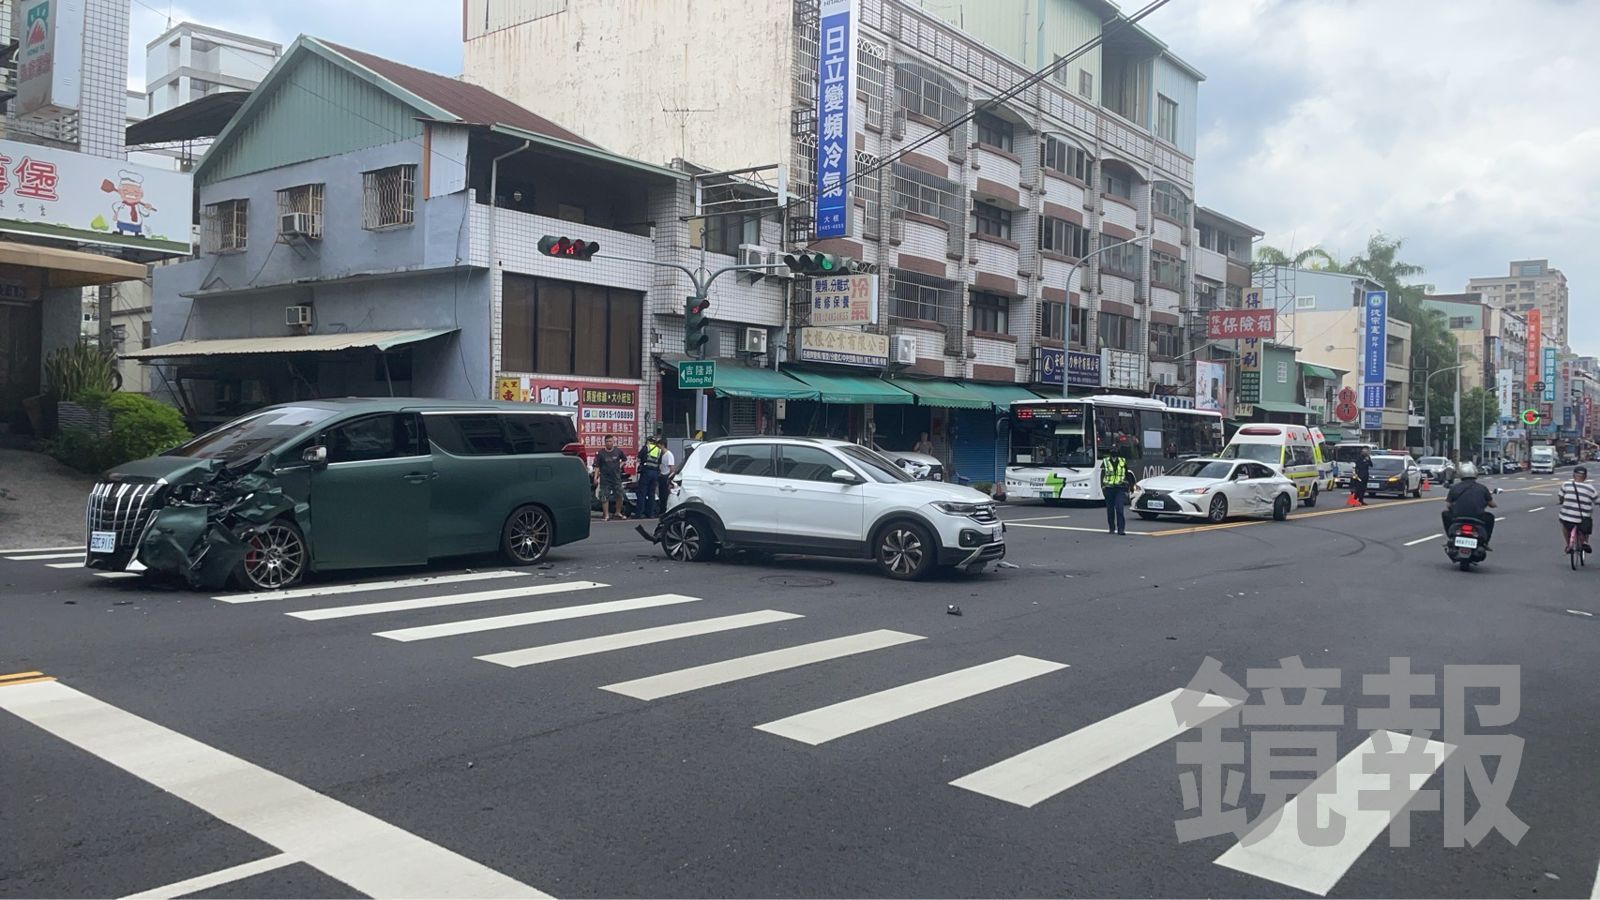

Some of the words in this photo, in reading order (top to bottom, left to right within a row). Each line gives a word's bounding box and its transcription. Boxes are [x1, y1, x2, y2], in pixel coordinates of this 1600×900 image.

[822, 25, 845, 198] 日立變頻冷氣
[851, 277, 869, 320] 冷氣
[1222, 315, 1272, 333] 保險箱
[1243, 292, 1261, 367] 得印刷
[685, 366, 712, 375] 吉隆路
[685, 376, 704, 384] Jilong
